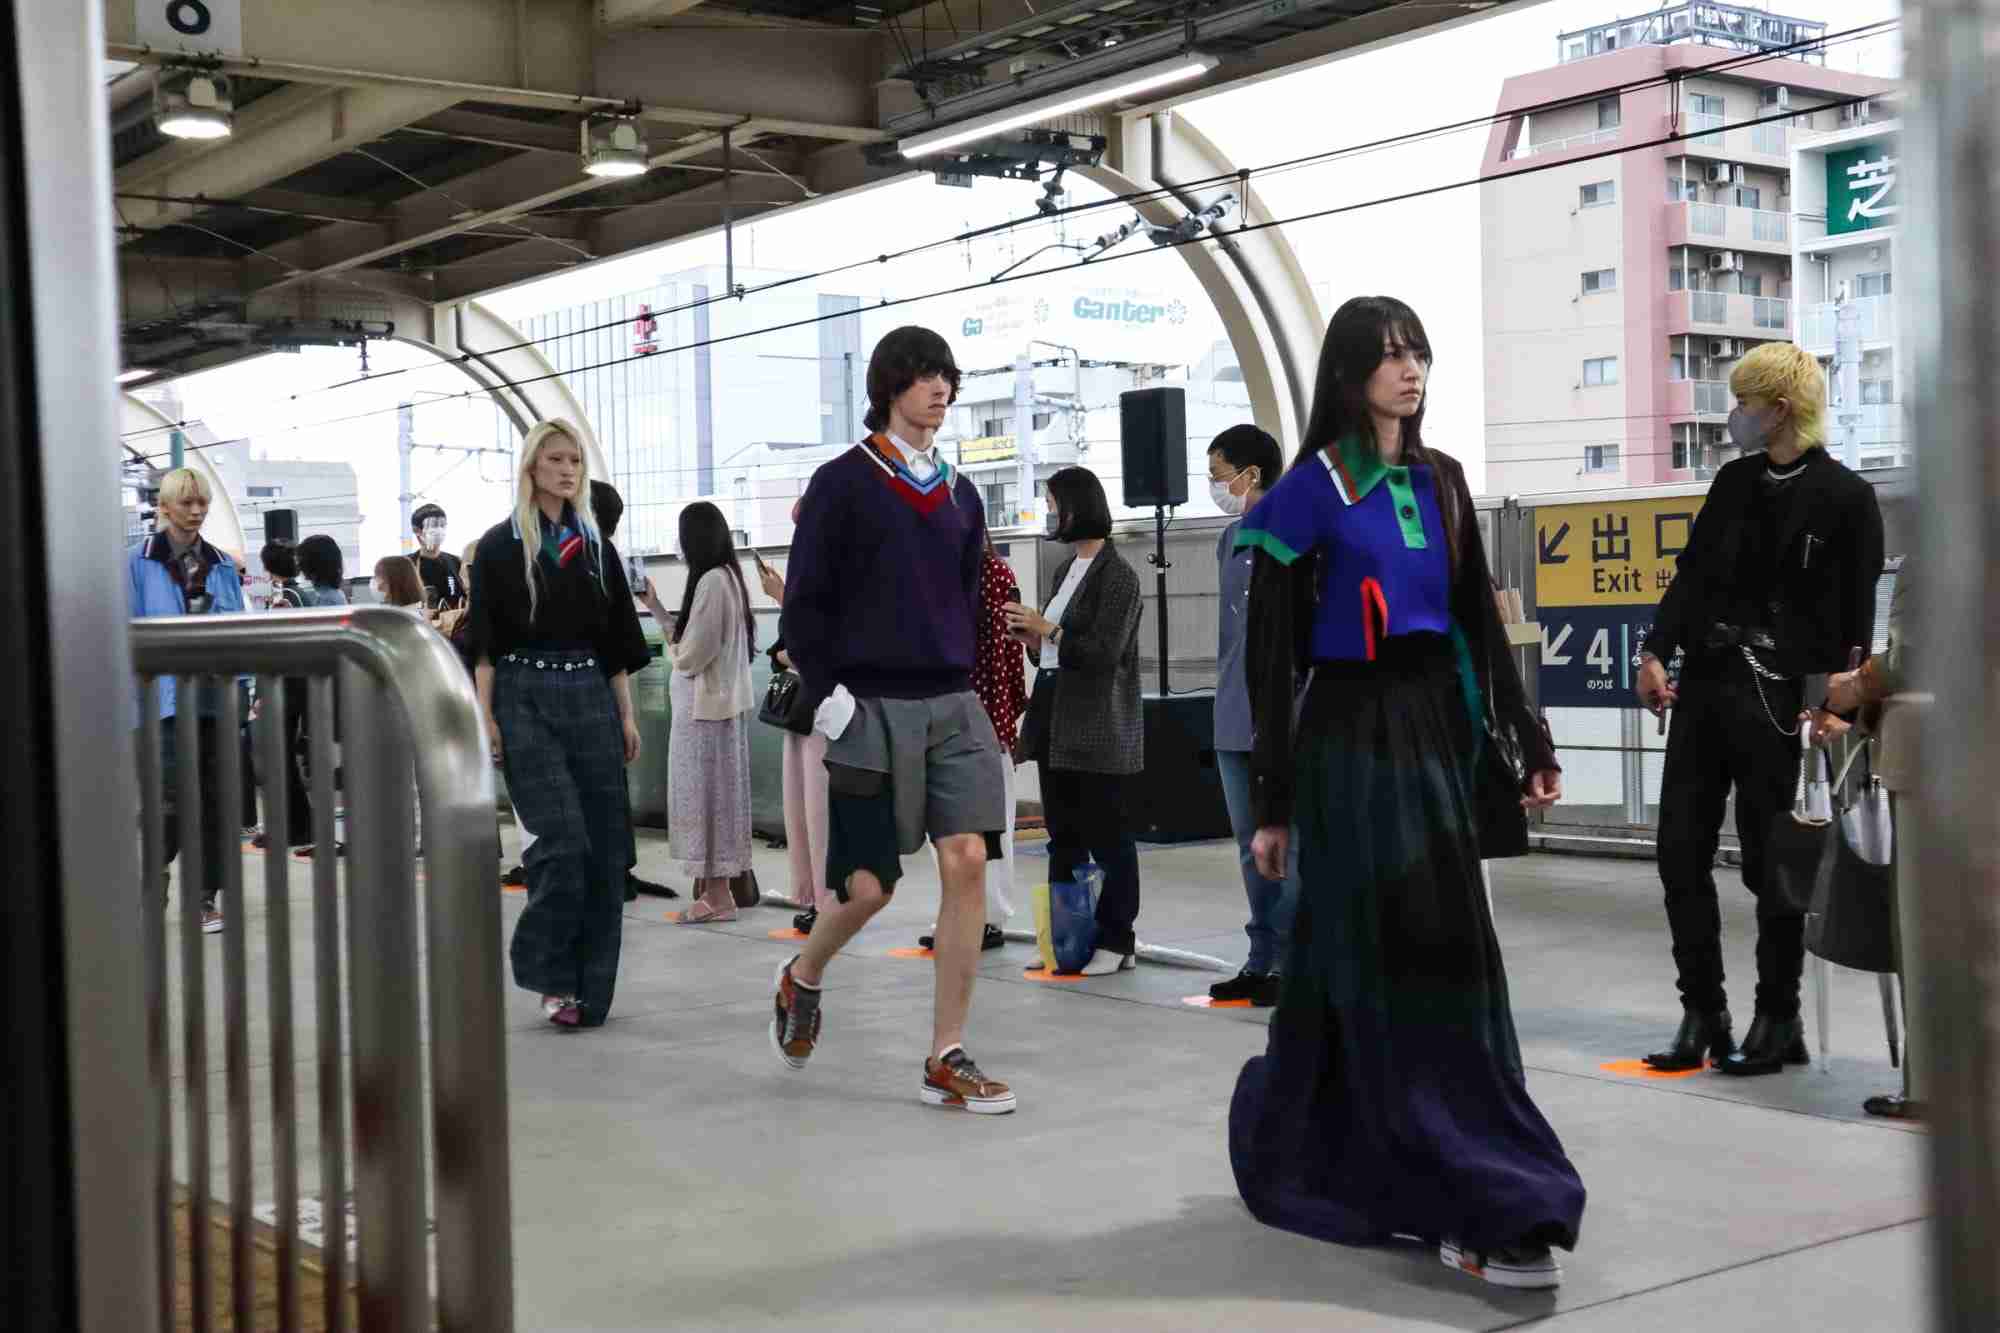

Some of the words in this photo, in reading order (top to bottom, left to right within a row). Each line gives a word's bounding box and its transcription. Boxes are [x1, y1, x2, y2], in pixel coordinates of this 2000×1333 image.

[1846, 156, 1902, 221] 芝
[1073, 296, 1164, 323] Ganter
[1592, 512, 1693, 562] 出口
[1593, 566, 1642, 593] Exit
[1586, 628, 1614, 675] 4
